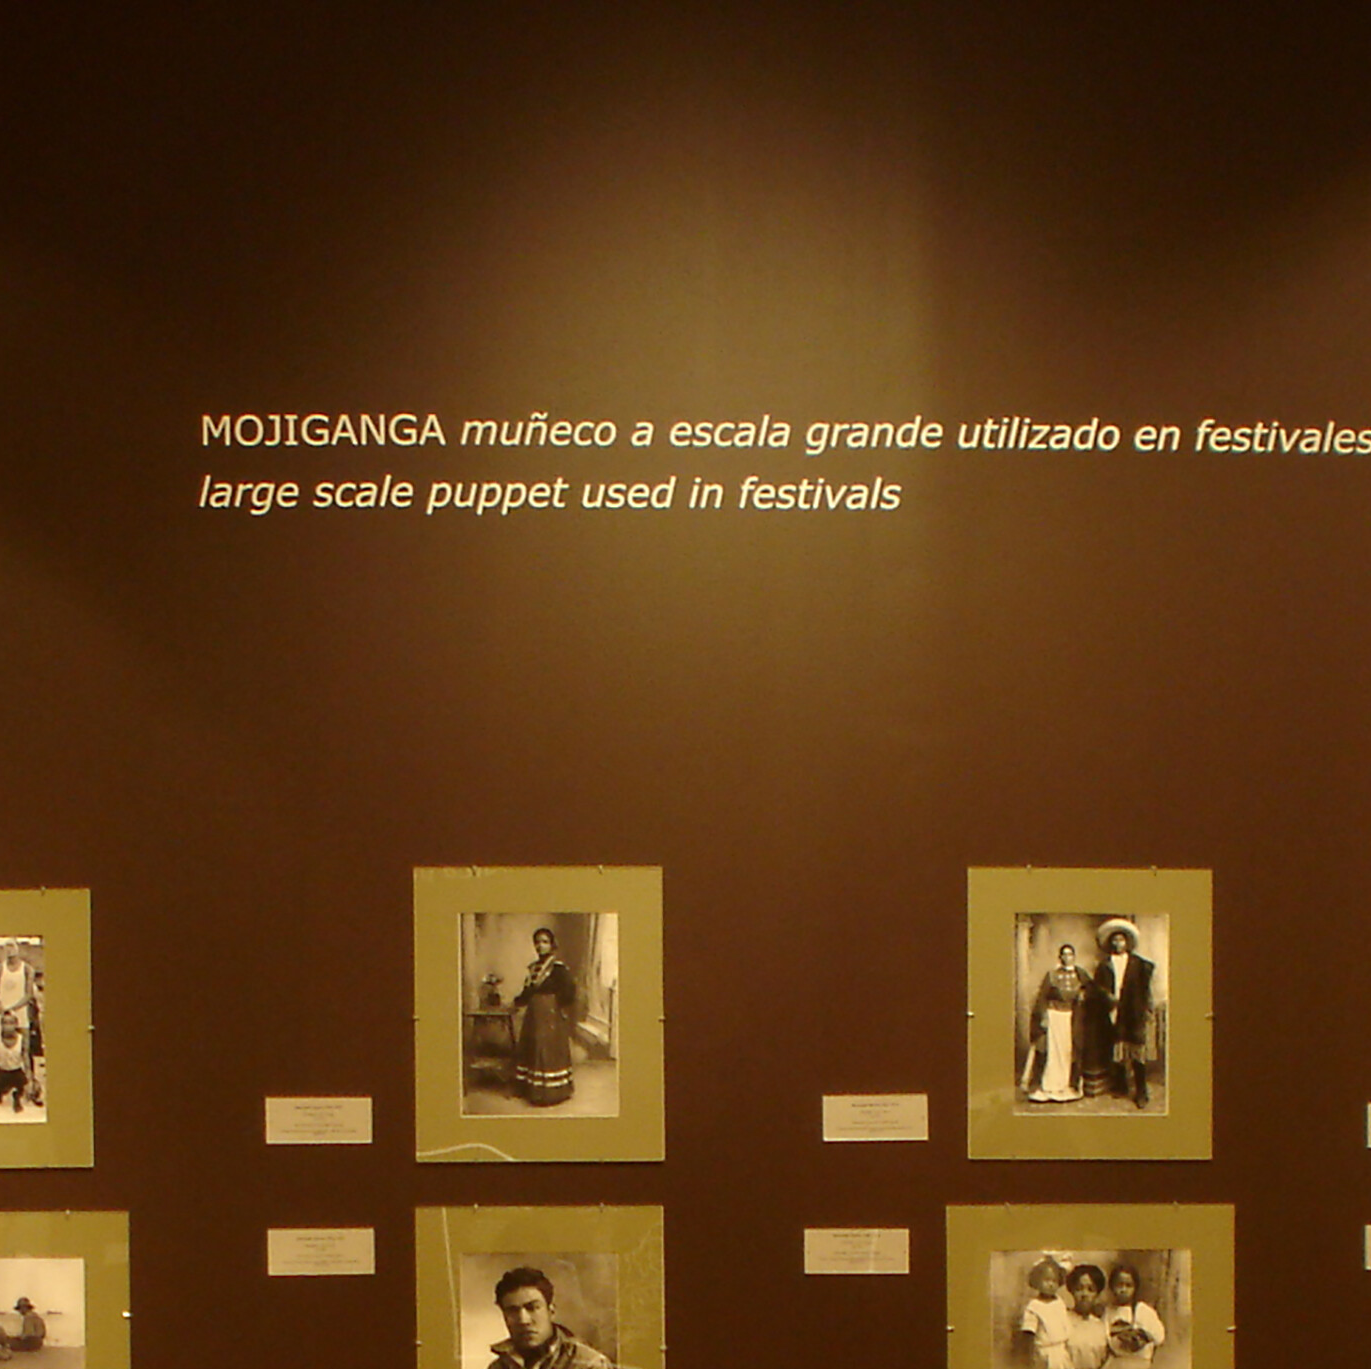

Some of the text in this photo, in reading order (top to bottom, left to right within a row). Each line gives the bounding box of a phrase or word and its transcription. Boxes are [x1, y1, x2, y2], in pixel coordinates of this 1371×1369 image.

[201, 414, 447, 447] MOJIGANGA
[460, 412, 617, 447] muñeco
[630, 421, 655, 447] a
[669, 413, 791, 447] escala
[805, 414, 944, 455] grande
[957, 415, 1121, 450] utilizado
[1133, 425, 1181, 451] en
[198, 474, 903, 515] large scale puppet used in festivals
